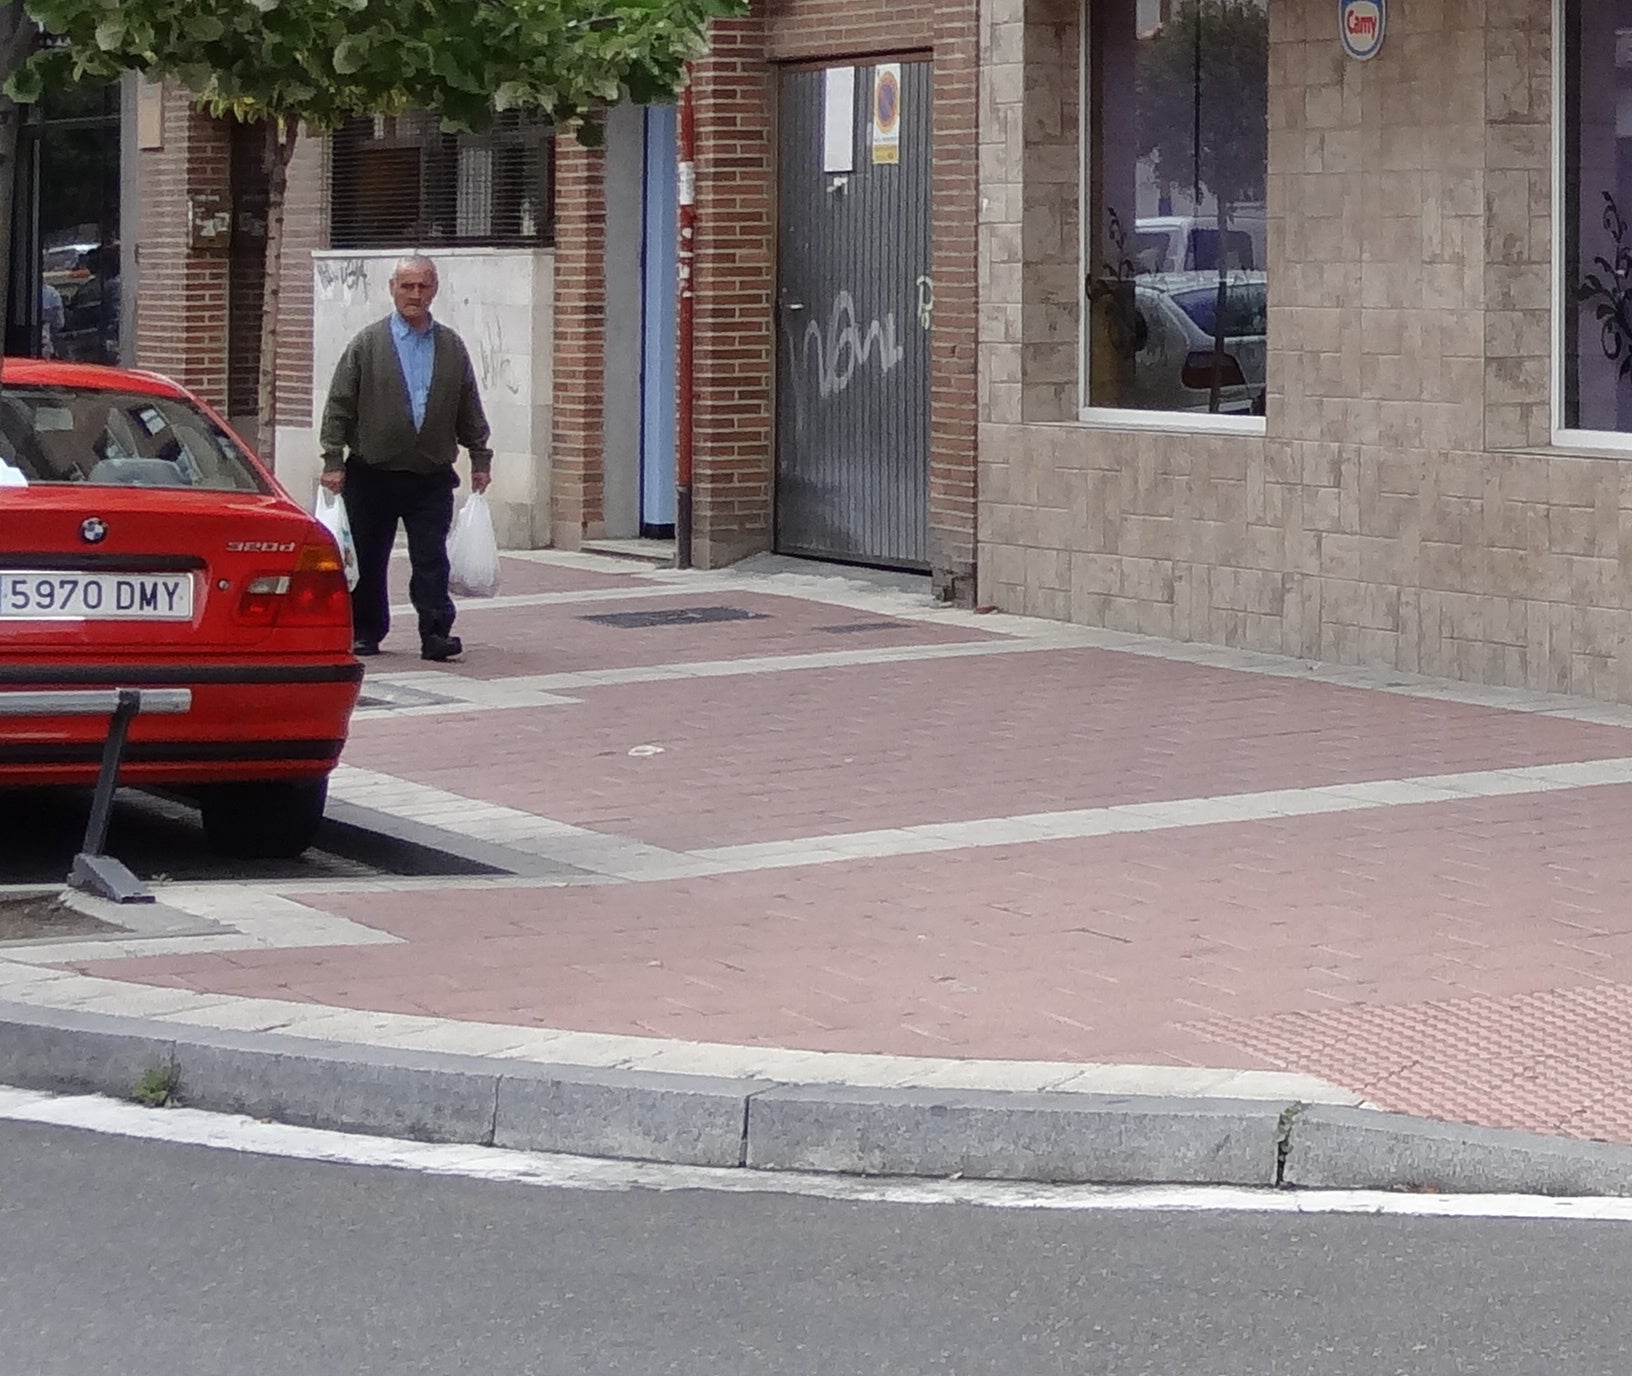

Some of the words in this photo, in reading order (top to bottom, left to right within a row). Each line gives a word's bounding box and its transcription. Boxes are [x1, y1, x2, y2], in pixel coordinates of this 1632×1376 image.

[1346, 9, 1377, 41] Camy
[225, 540, 296, 554] 320d
[10, 579, 103, 611] 5970
[115, 580, 181, 612] DMY
